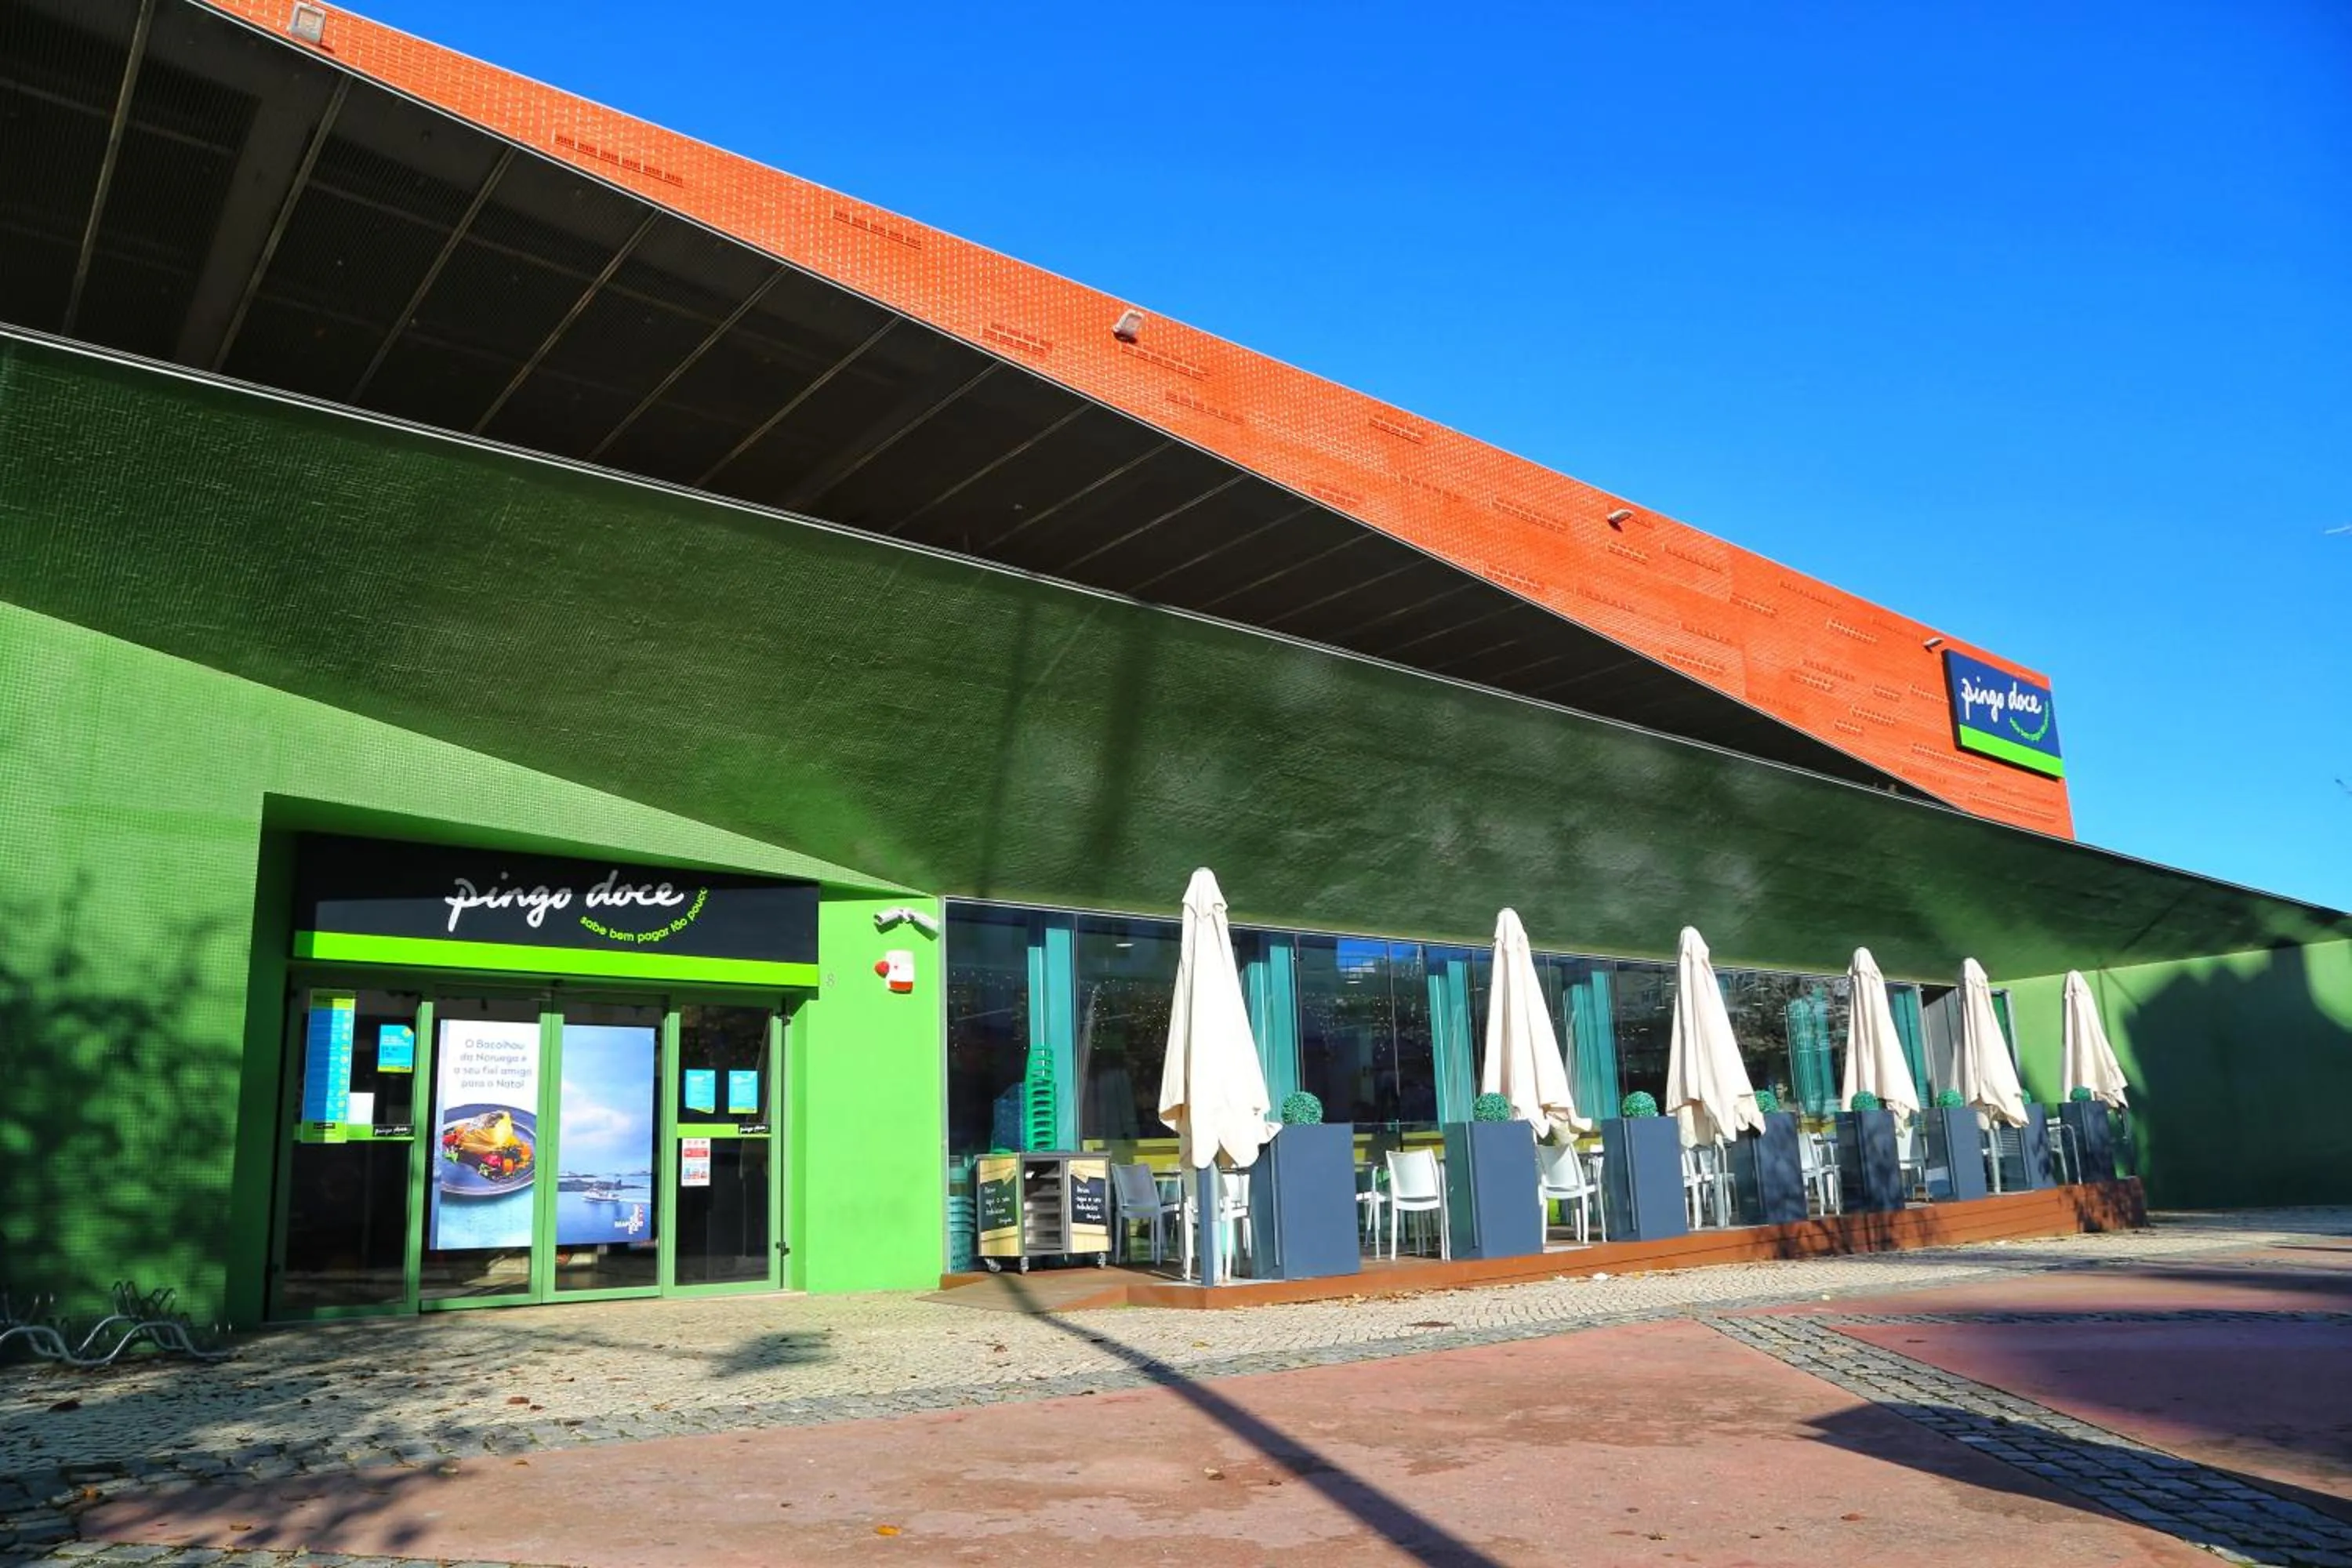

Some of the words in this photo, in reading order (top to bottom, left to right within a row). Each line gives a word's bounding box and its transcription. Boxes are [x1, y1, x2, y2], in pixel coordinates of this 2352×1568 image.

[1961, 676, 2005, 723] pingo
[2008, 681, 2042, 714] doce
[445, 871, 573, 932] pingo
[585, 869, 684, 909] doce
[579, 916, 607, 935] sabe
[609, 927, 634, 942] bem
[637, 927, 669, 944] pagar
[465, 1039, 474, 1048] O
[476, 1039, 524, 1049] Bacalhau
[476, 1053, 519, 1063] Noruega
[482, 1065, 498, 1075] fiel
[500, 1068, 532, 1078] amigo
[461, 1080, 485, 1089] para
[496, 1079, 525, 1089] Natal
